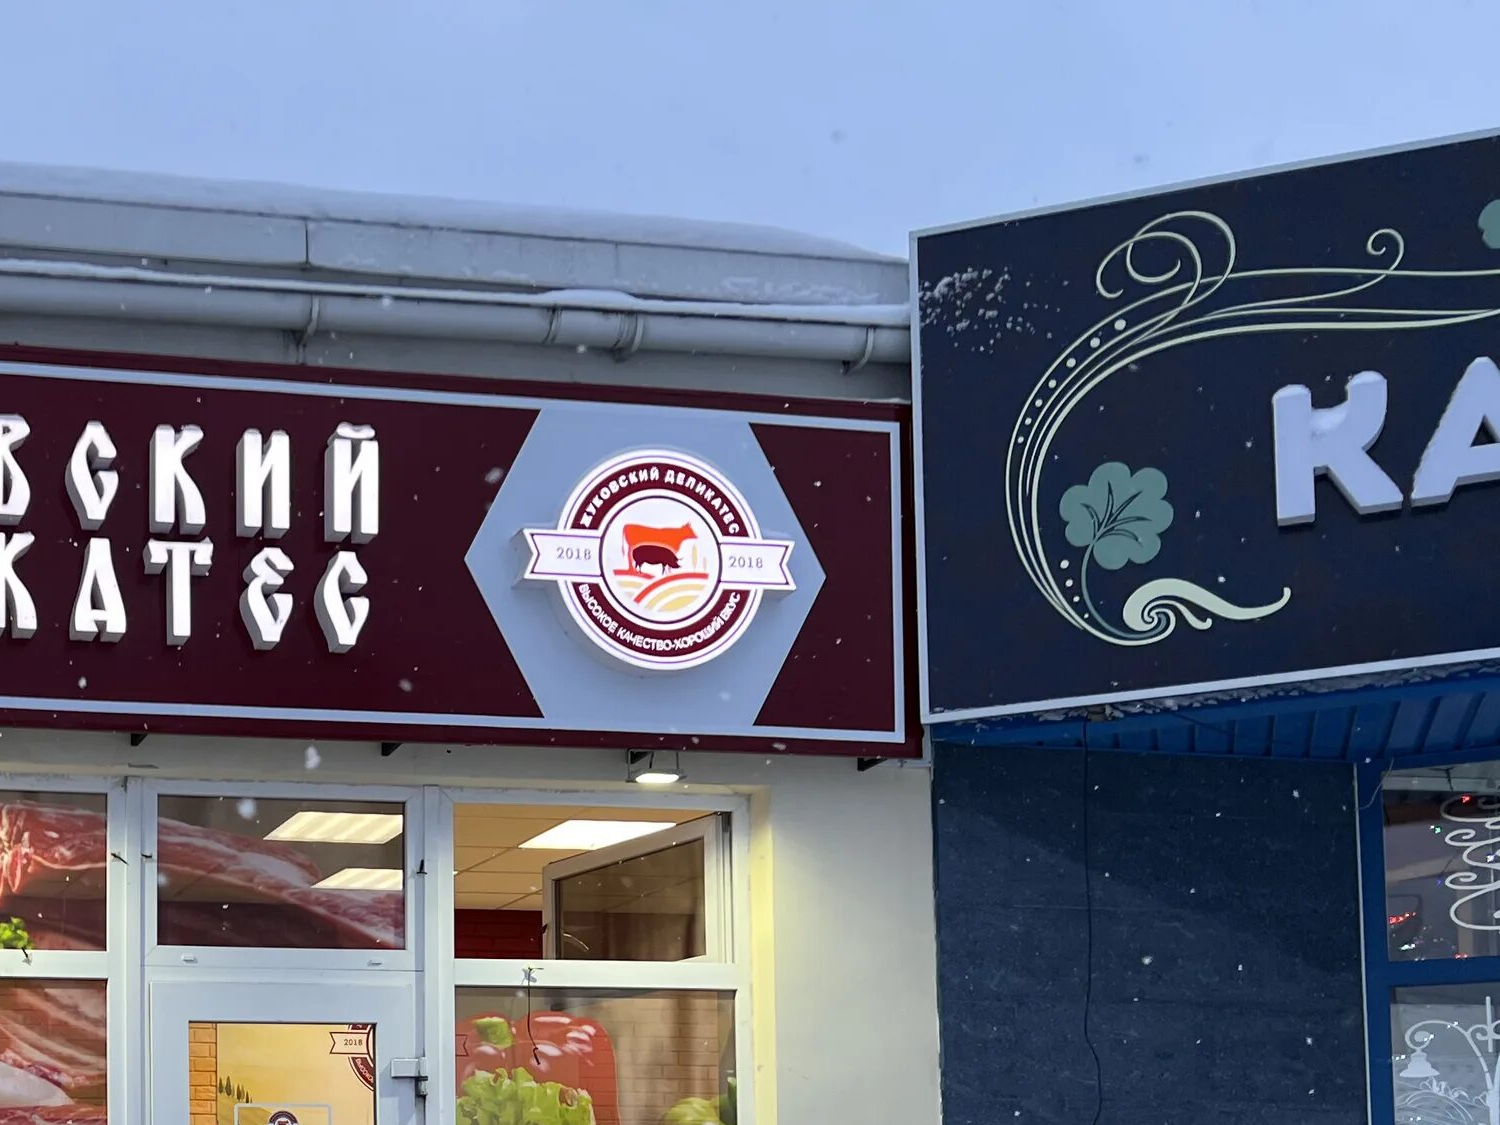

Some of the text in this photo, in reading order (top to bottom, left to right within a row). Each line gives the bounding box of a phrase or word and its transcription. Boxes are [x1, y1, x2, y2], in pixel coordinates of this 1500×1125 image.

[580, 466, 740, 535] ЖУКОВСКИЙ ДЕЛИКАТЕС
[556, 546, 592, 561] 2018
[728, 555, 763, 569] 2018
[578, 583, 617, 634] ВЫСОКОЕ
[720, 591, 741, 622] ВКУС
[343, 1038, 363, 1047] 2018
